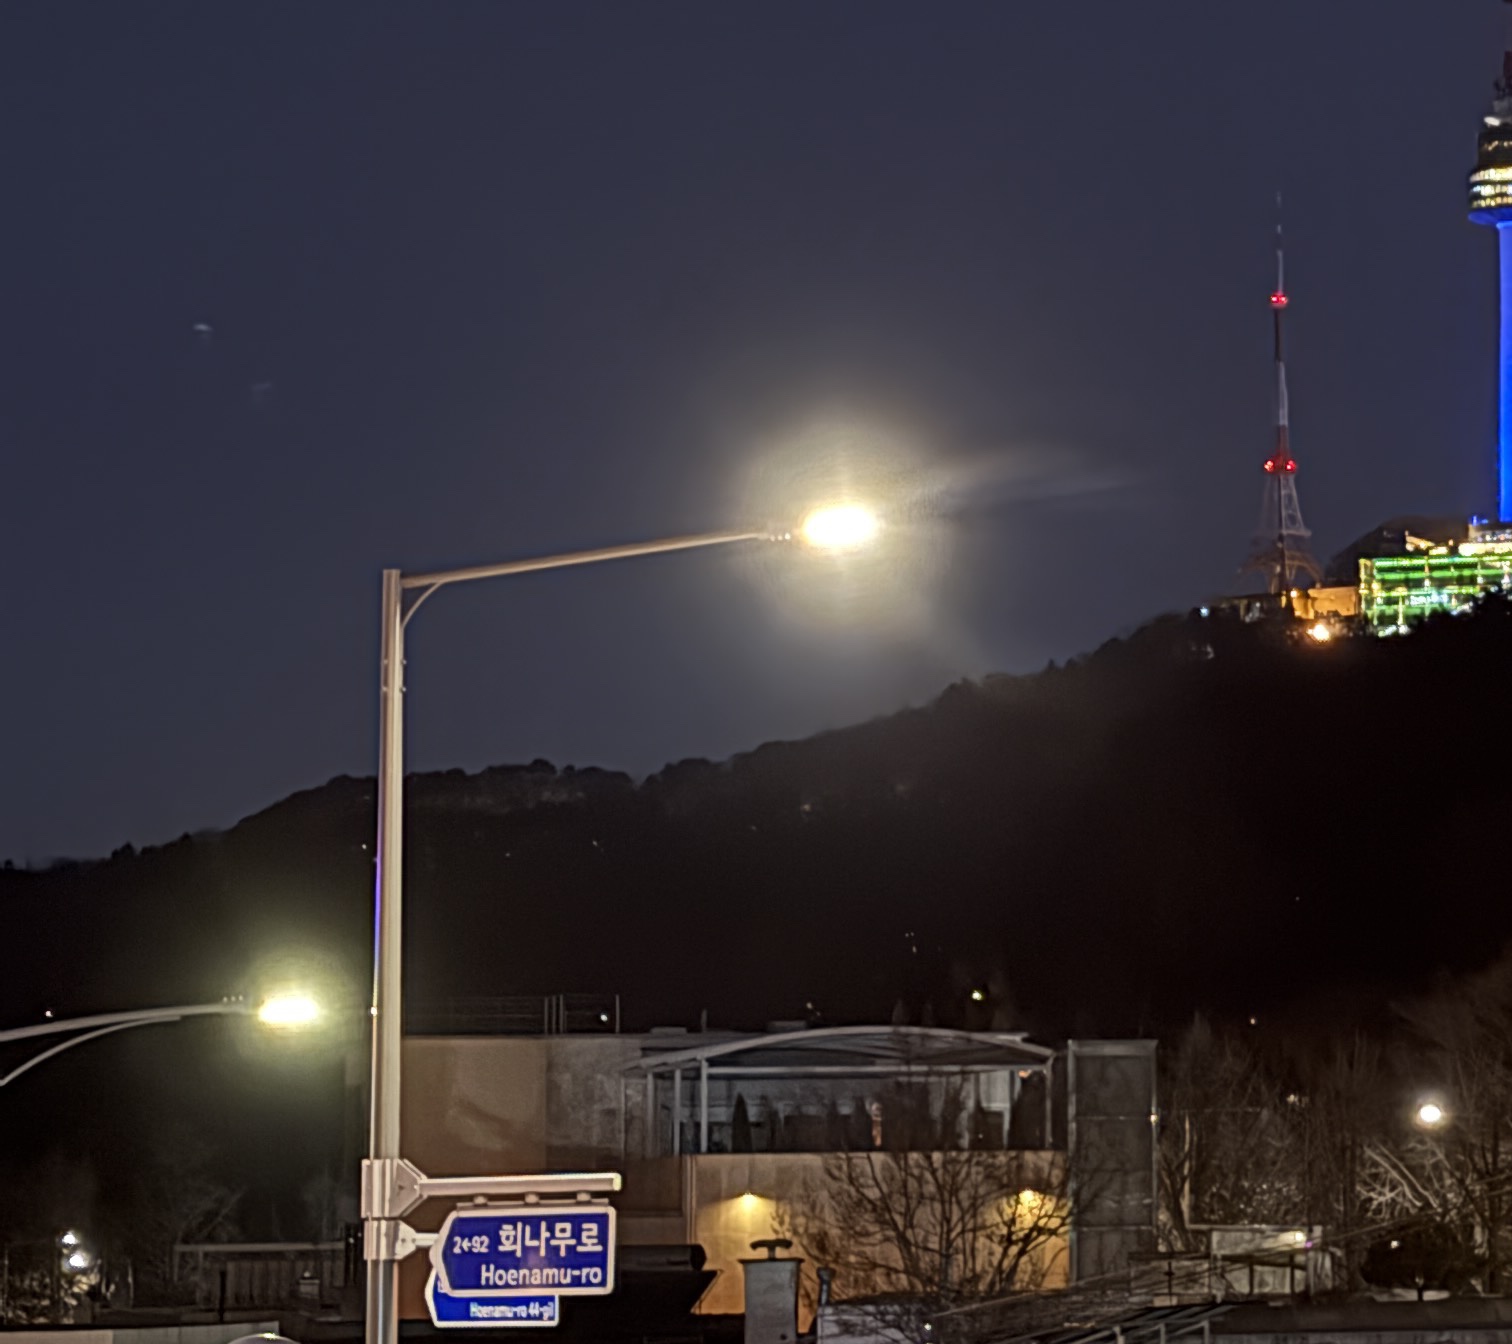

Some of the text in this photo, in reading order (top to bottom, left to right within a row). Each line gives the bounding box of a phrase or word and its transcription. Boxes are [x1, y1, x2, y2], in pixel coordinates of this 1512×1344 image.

[498, 1220, 604, 1258] 회나무로
[480, 1263, 602, 1286] Hoenamu-ro
[469, 1301, 528, 1318] Hoenamu-ro
